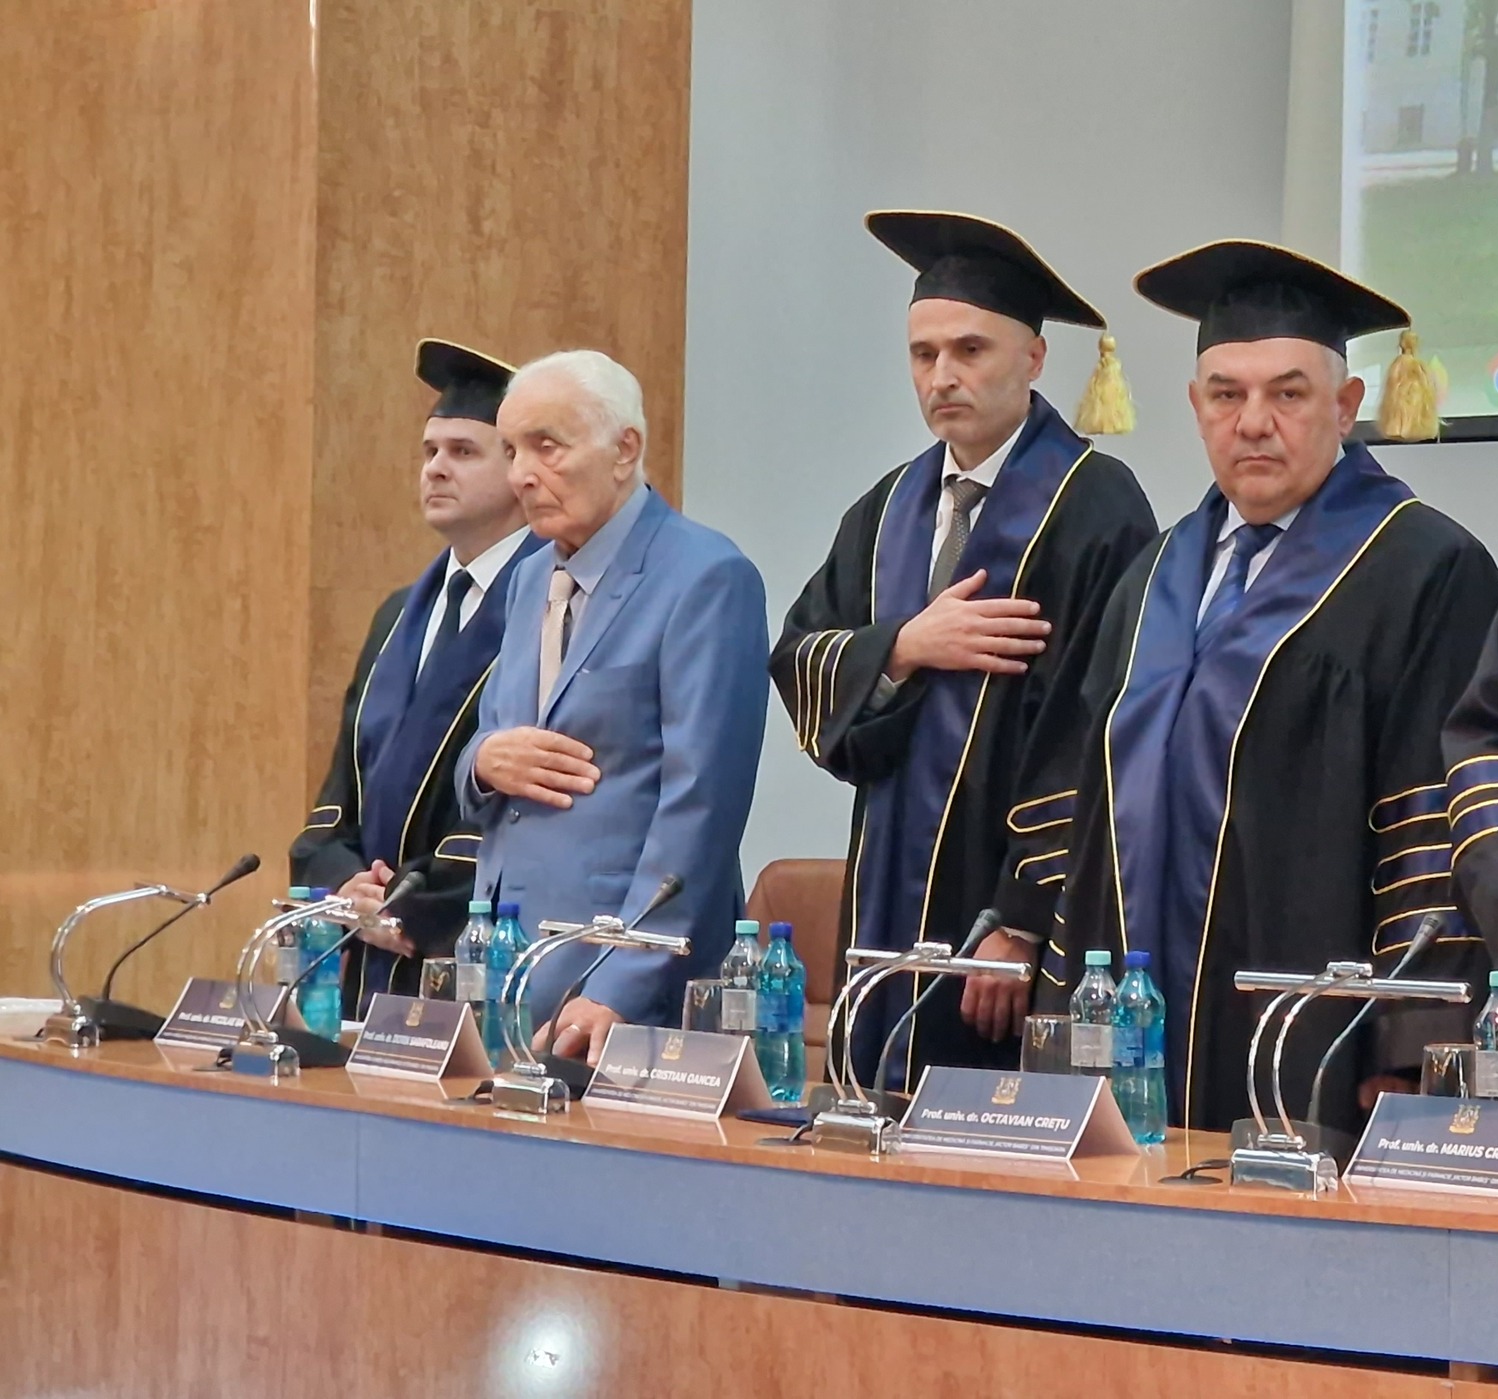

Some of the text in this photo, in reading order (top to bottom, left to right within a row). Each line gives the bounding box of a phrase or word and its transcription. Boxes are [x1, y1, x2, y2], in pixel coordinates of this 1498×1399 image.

[605, 1064, 622, 1074] Prof.
[639, 1068, 650, 1078] dr.
[650, 1068, 688, 1083] CRISTIAN
[921, 1108, 1071, 1132] Prof. univ. dr. OCTAVIAN CREȚU
[1378, 1138, 1401, 1150] Prof.
[1401, 1140, 1425, 1152] univ.
[1426, 1142, 1439, 1154] dr.
[1440, 1143, 1485, 1158] MARIUS
